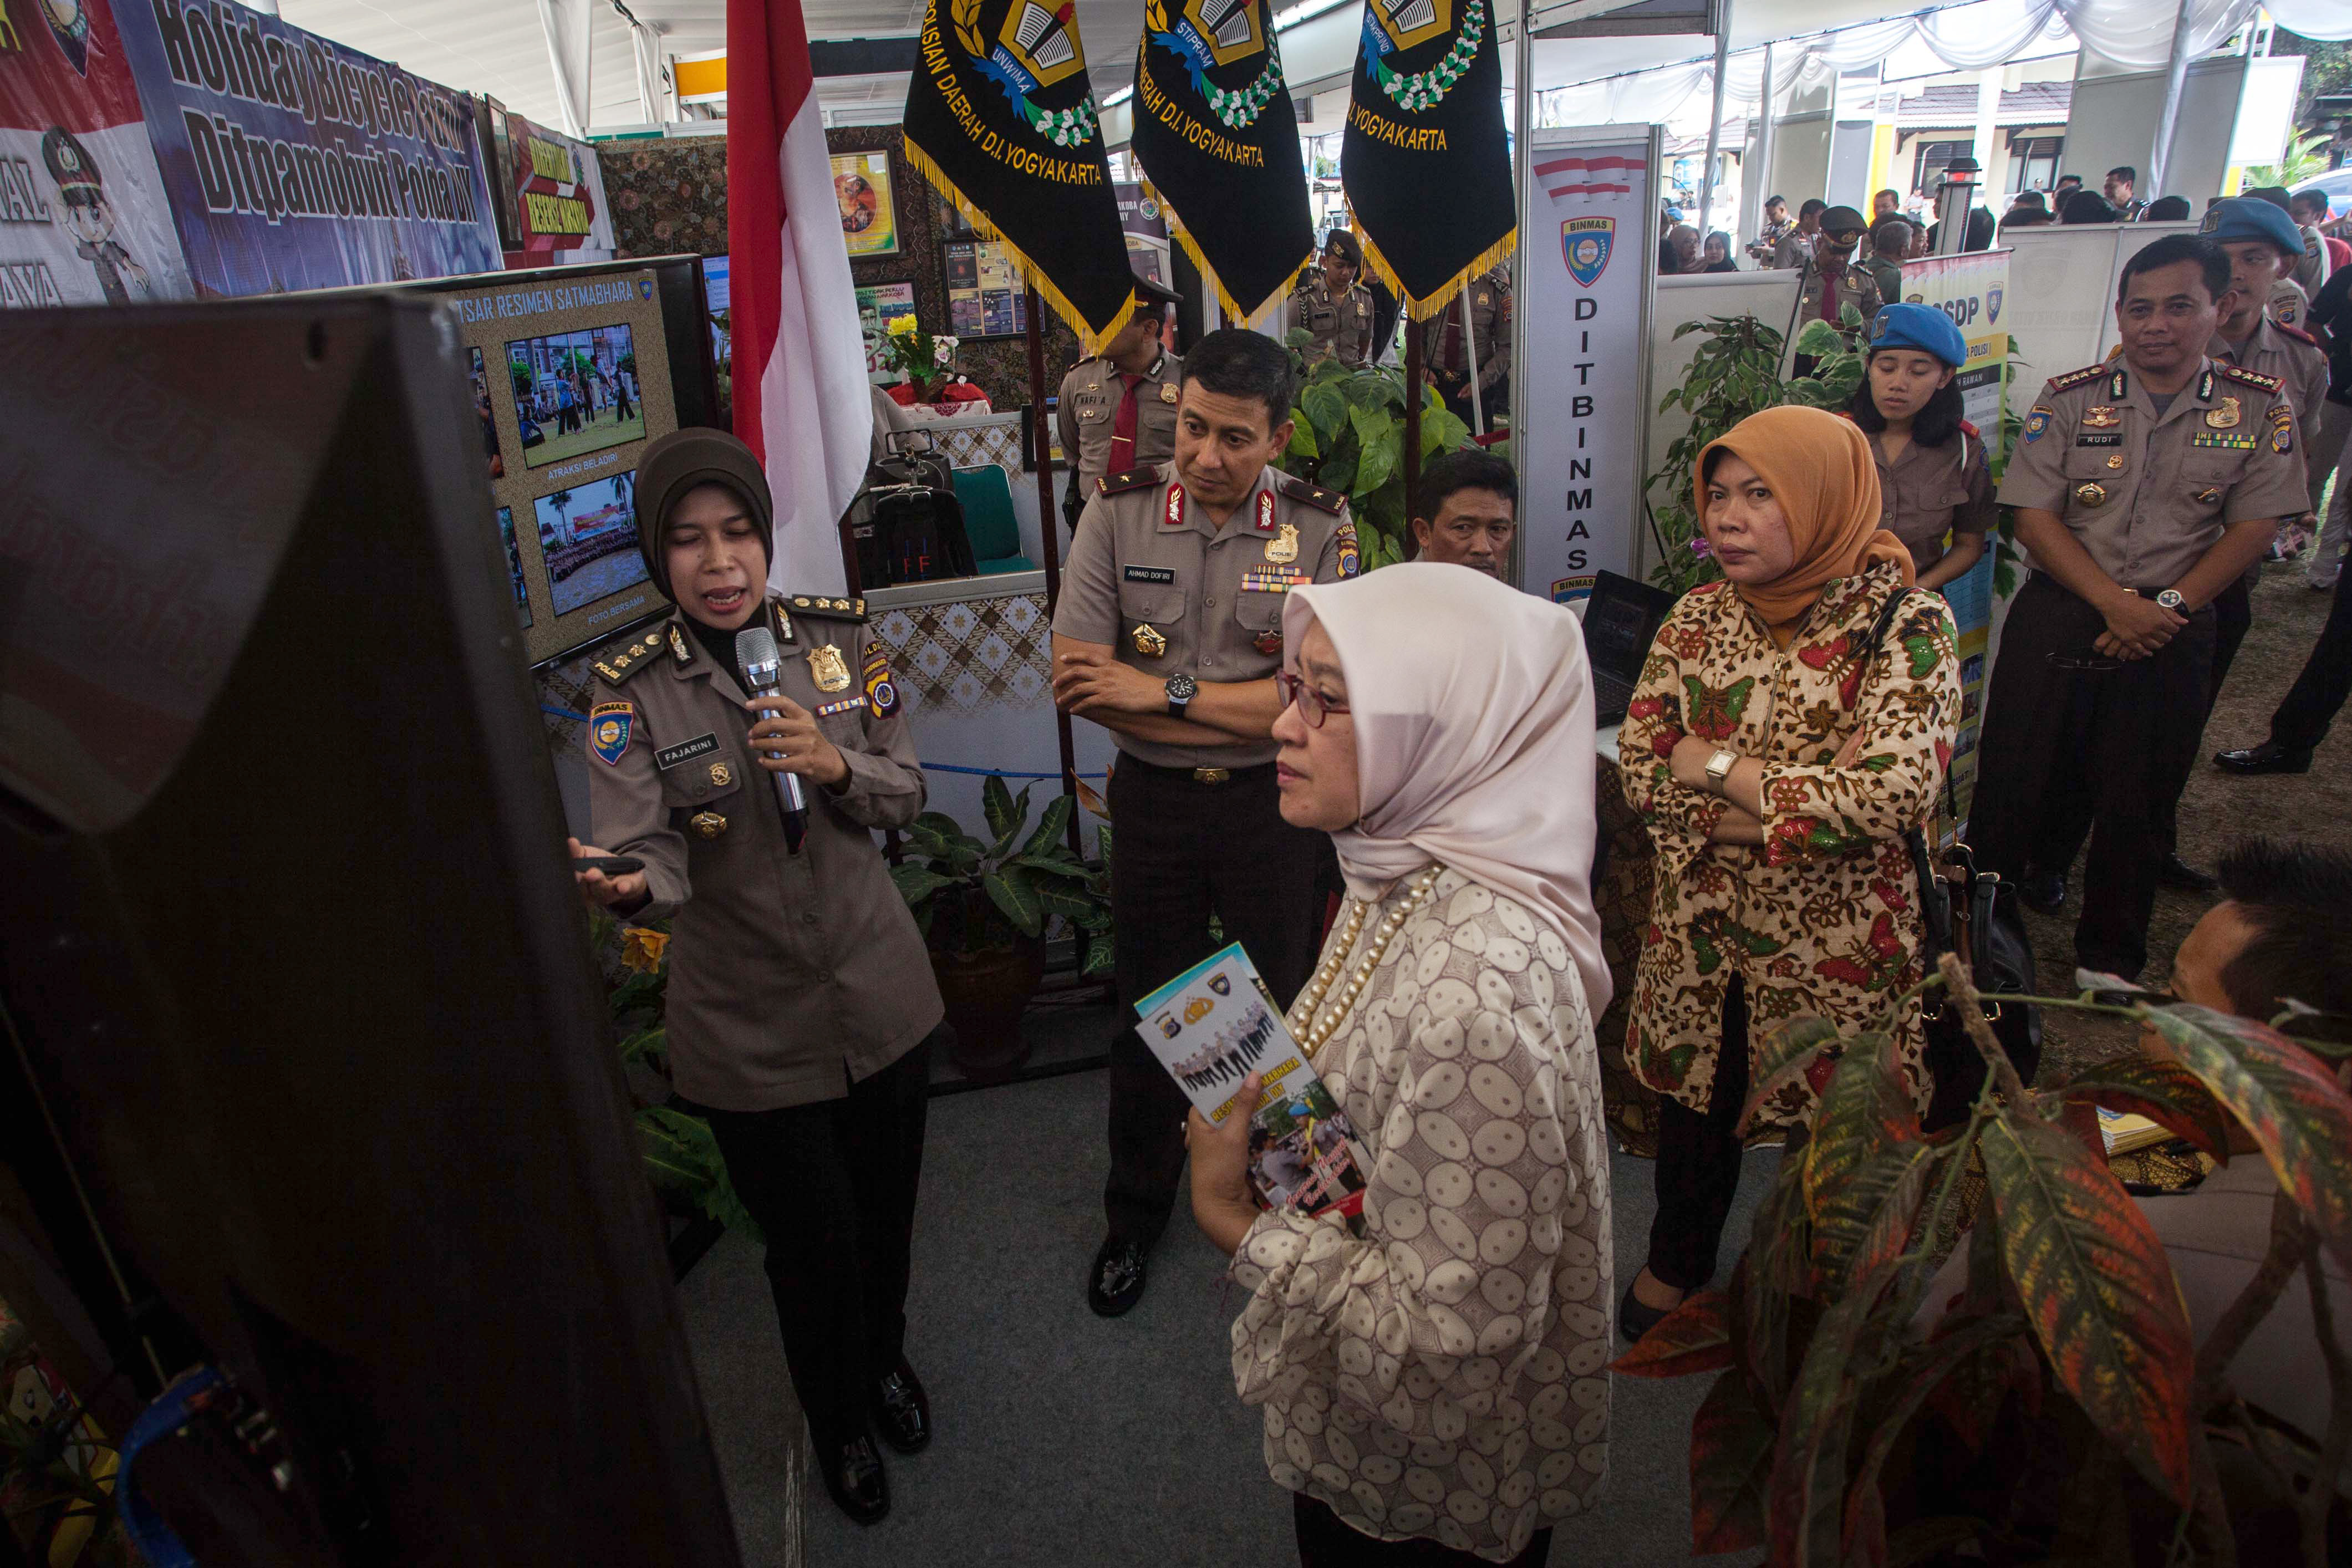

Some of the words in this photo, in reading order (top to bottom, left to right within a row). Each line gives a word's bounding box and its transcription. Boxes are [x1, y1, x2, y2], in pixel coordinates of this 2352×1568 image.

[1177, 22, 1213, 68] STIPRAM
[151, 0, 317, 124] Holiday
[302, 33, 414, 139] Bicycle
[992, 47, 1031, 94] UNWIMA
[936, 73, 986, 141] DAERAH
[1005, 142, 1103, 185] YOGYAKARTA
[1355, 105, 1447, 151] YOGYAKARTA
[1182, 119, 1264, 167] YOGYAKARTA
[180, 105, 399, 225] Ditpamobvit
[388, 148, 454, 222] Polda
[446, 162, 479, 225] DIY
[1117, 201, 1138, 210] RKOBA
[1570, 221, 1607, 231] BINMAS
[456, 297, 495, 323] TSAR
[496, 289, 554, 318] RESIMEN
[555, 281, 634, 310] SATMABHARA
[1933, 296, 1979, 327] SDP
[1970, 343, 1988, 358] POLISI
[1962, 373, 1983, 387] RAWAN
[547, 462, 582, 480] ATRAKSI
[583, 452, 618, 470] BELADIRI
[1334, 496, 1345, 510] POLISI
[1128, 569, 1149, 578] AHMAD
[1150, 572, 1170, 580] DOFIRI
[1559, 579, 1593, 590] BINMAS
[588, 610, 608, 626] FOTO
[610, 595, 646, 617] BERSAMA
[594, 661, 621, 679] POLISI
[665, 740, 712, 761] FAJARINI
